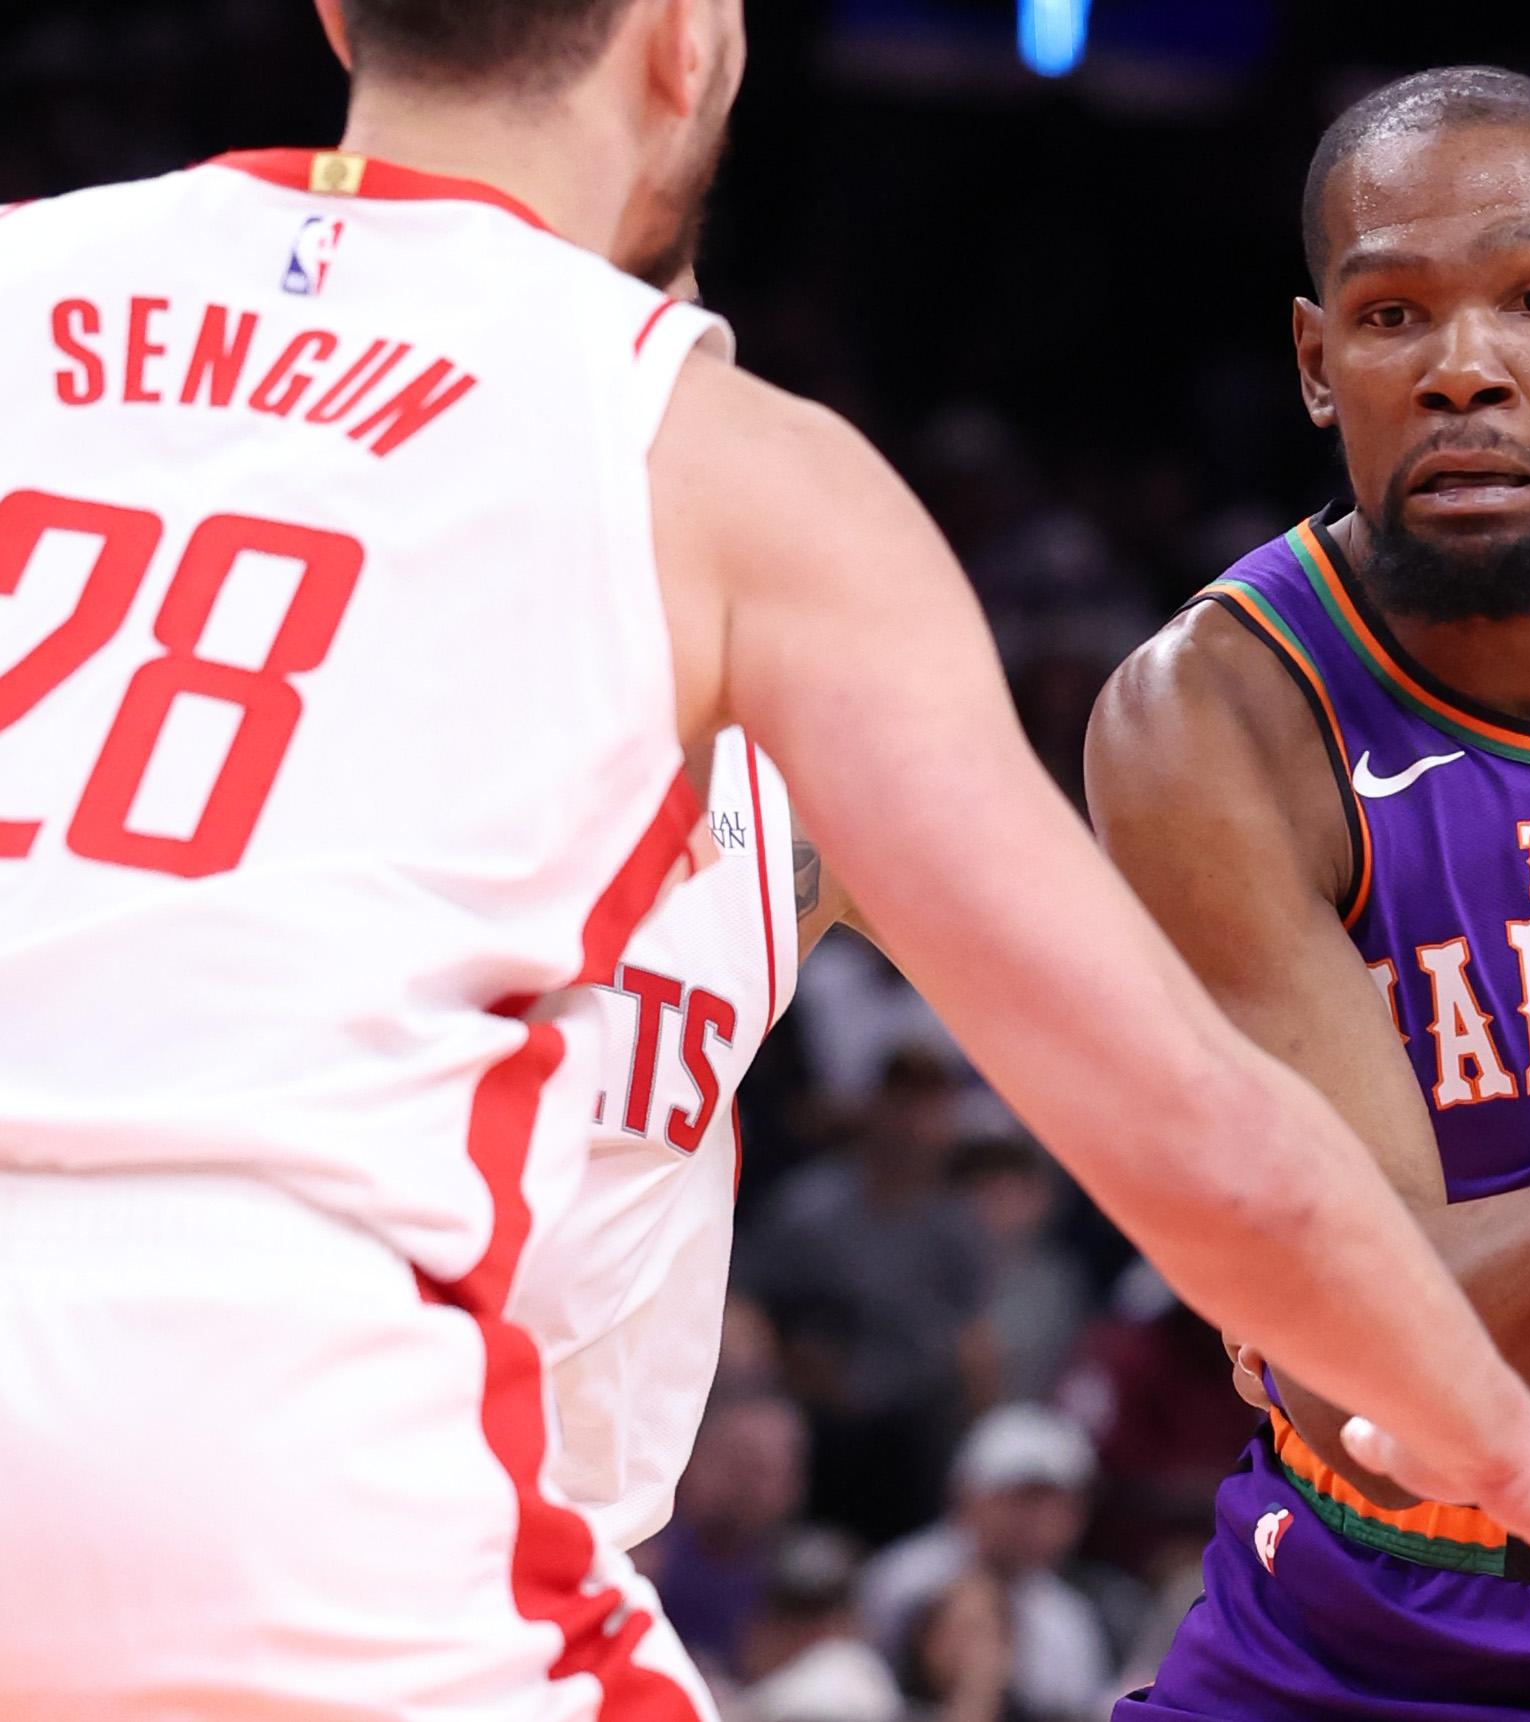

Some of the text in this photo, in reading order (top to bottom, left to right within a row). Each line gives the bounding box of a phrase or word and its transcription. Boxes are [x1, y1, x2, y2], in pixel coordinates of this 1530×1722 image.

[51, 296, 477, 458] SENGUN
[0, 489, 365, 880] 28
[592, 961, 738, 1157] TS
